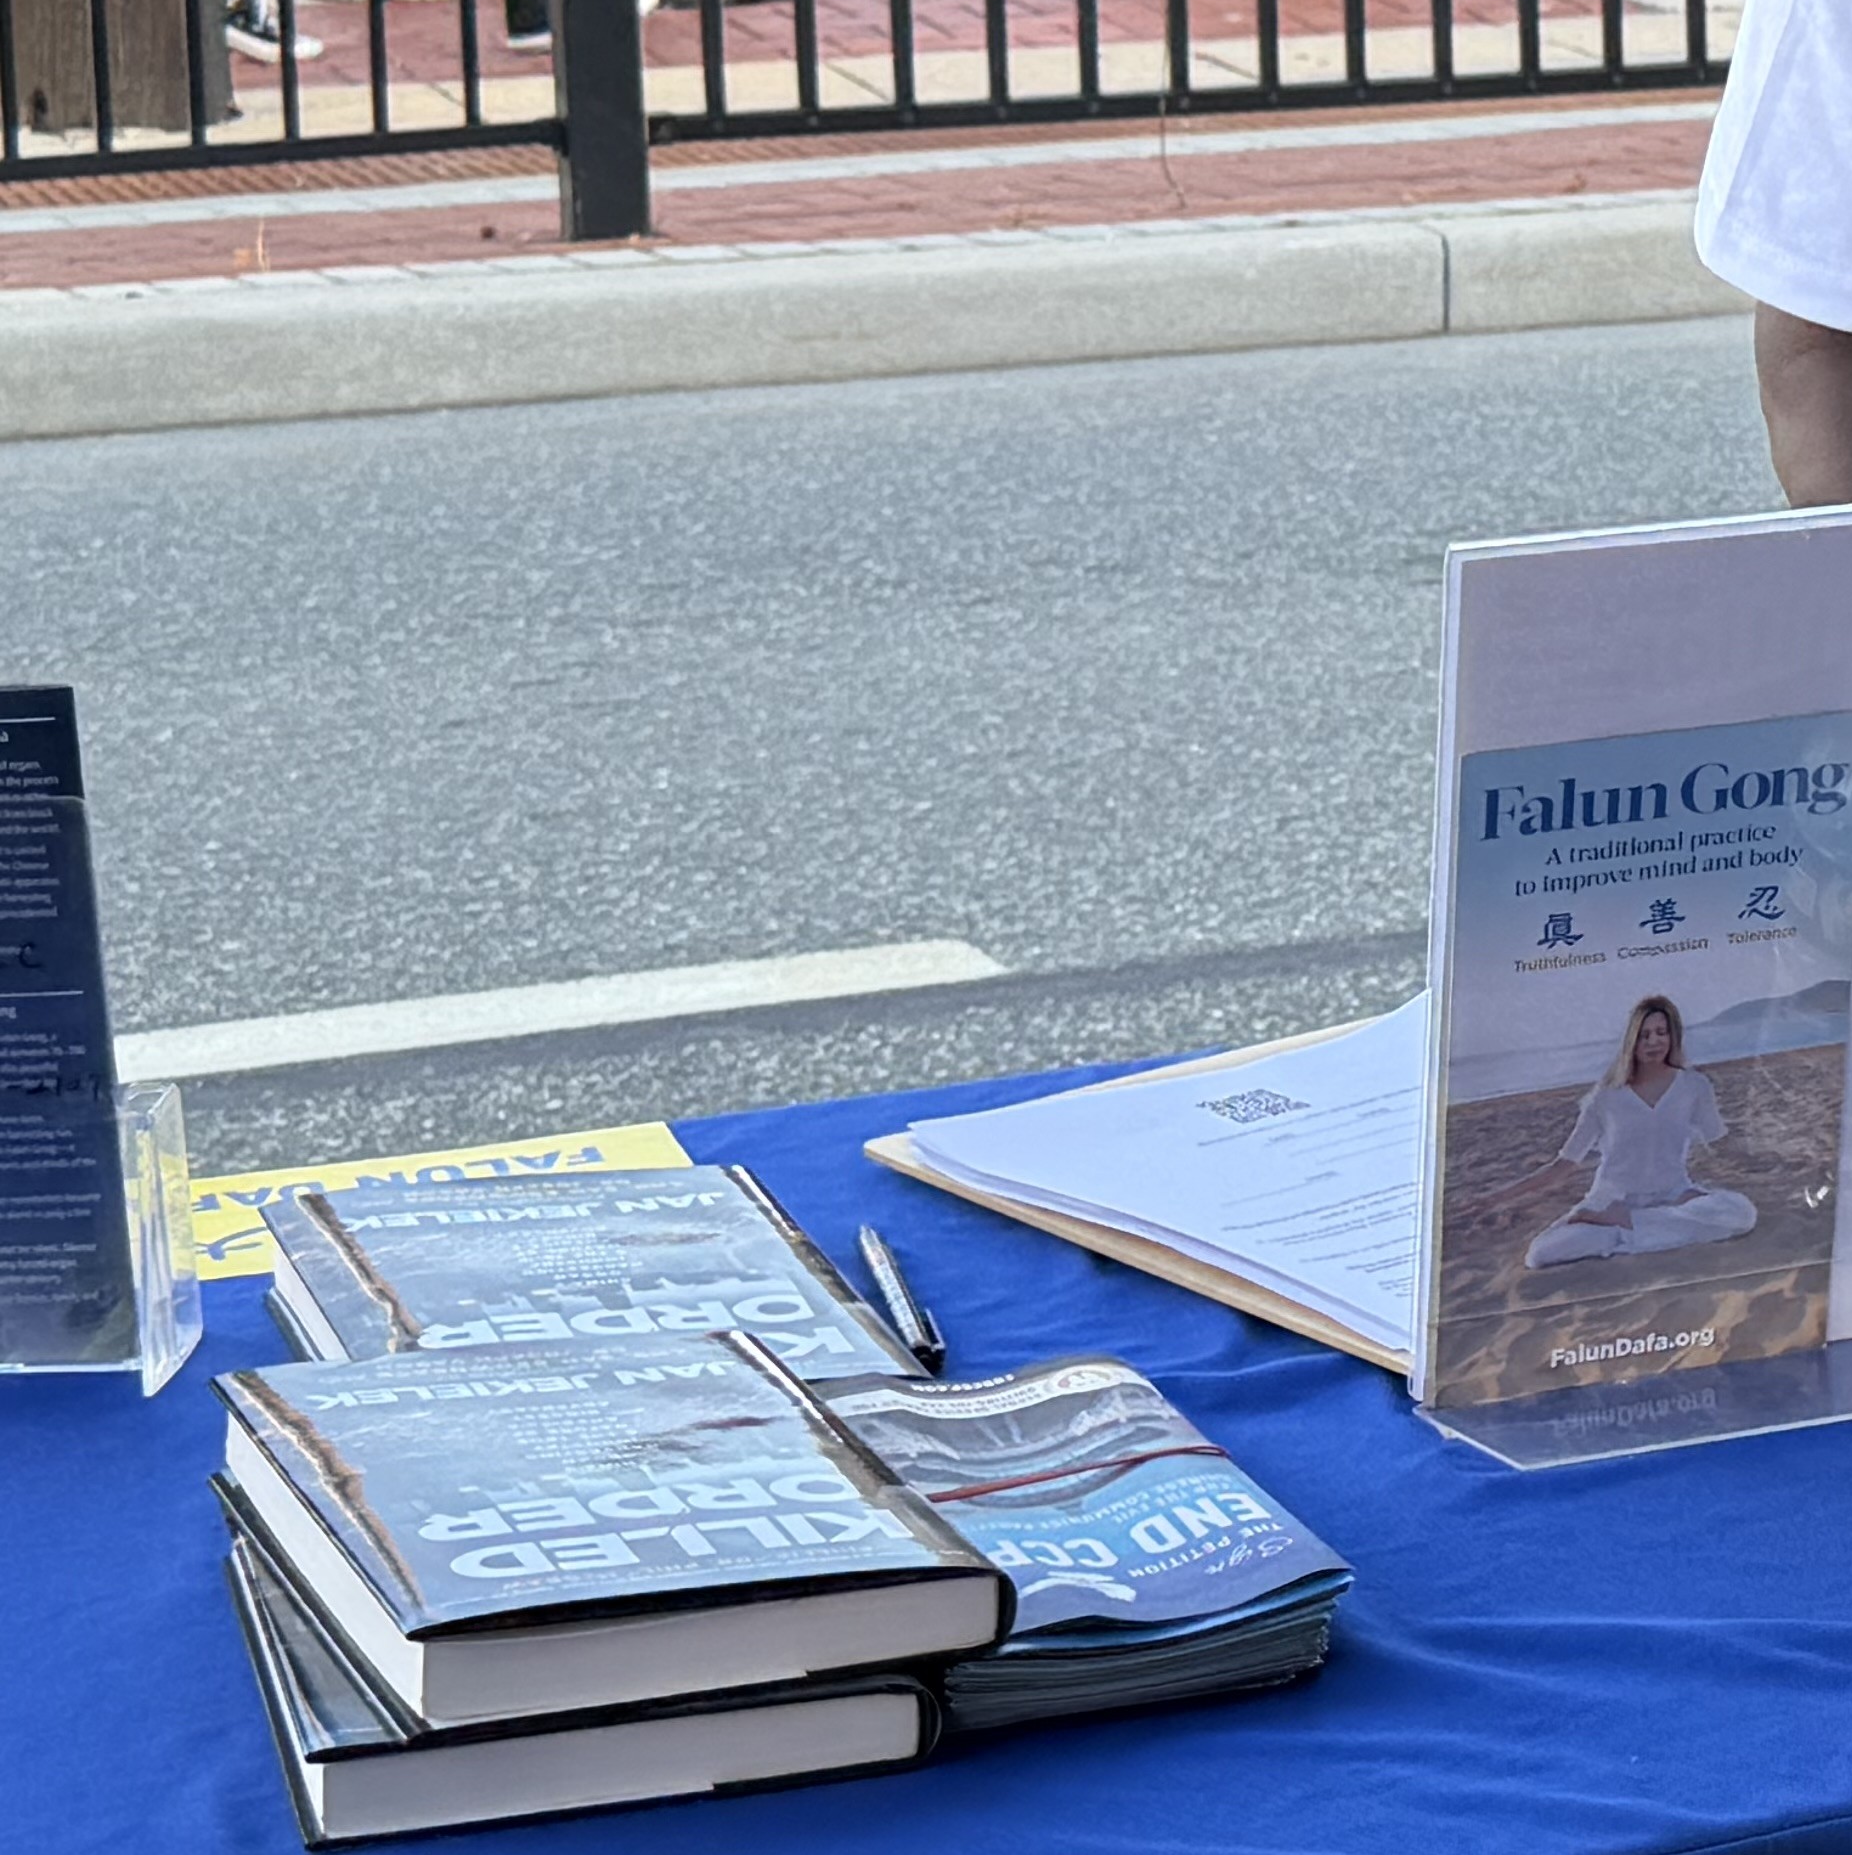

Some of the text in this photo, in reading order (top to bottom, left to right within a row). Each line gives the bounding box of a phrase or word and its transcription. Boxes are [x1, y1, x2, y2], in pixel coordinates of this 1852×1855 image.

[1480, 762, 1850, 842] Falun Gong
[1515, 845, 1804, 897] to improve mind and body
[1544, 824, 1778, 867] A traditional practice
[1513, 950, 1608, 974] Truthfulness
[416, 1292, 815, 1350] ORDER
[1550, 1326, 1715, 1369] FalunDafa.org
[415, 1472, 857, 1544] ORDER
[987, 1492, 1272, 1568] END CCP
[448, 1507, 915, 1580] KILLED
